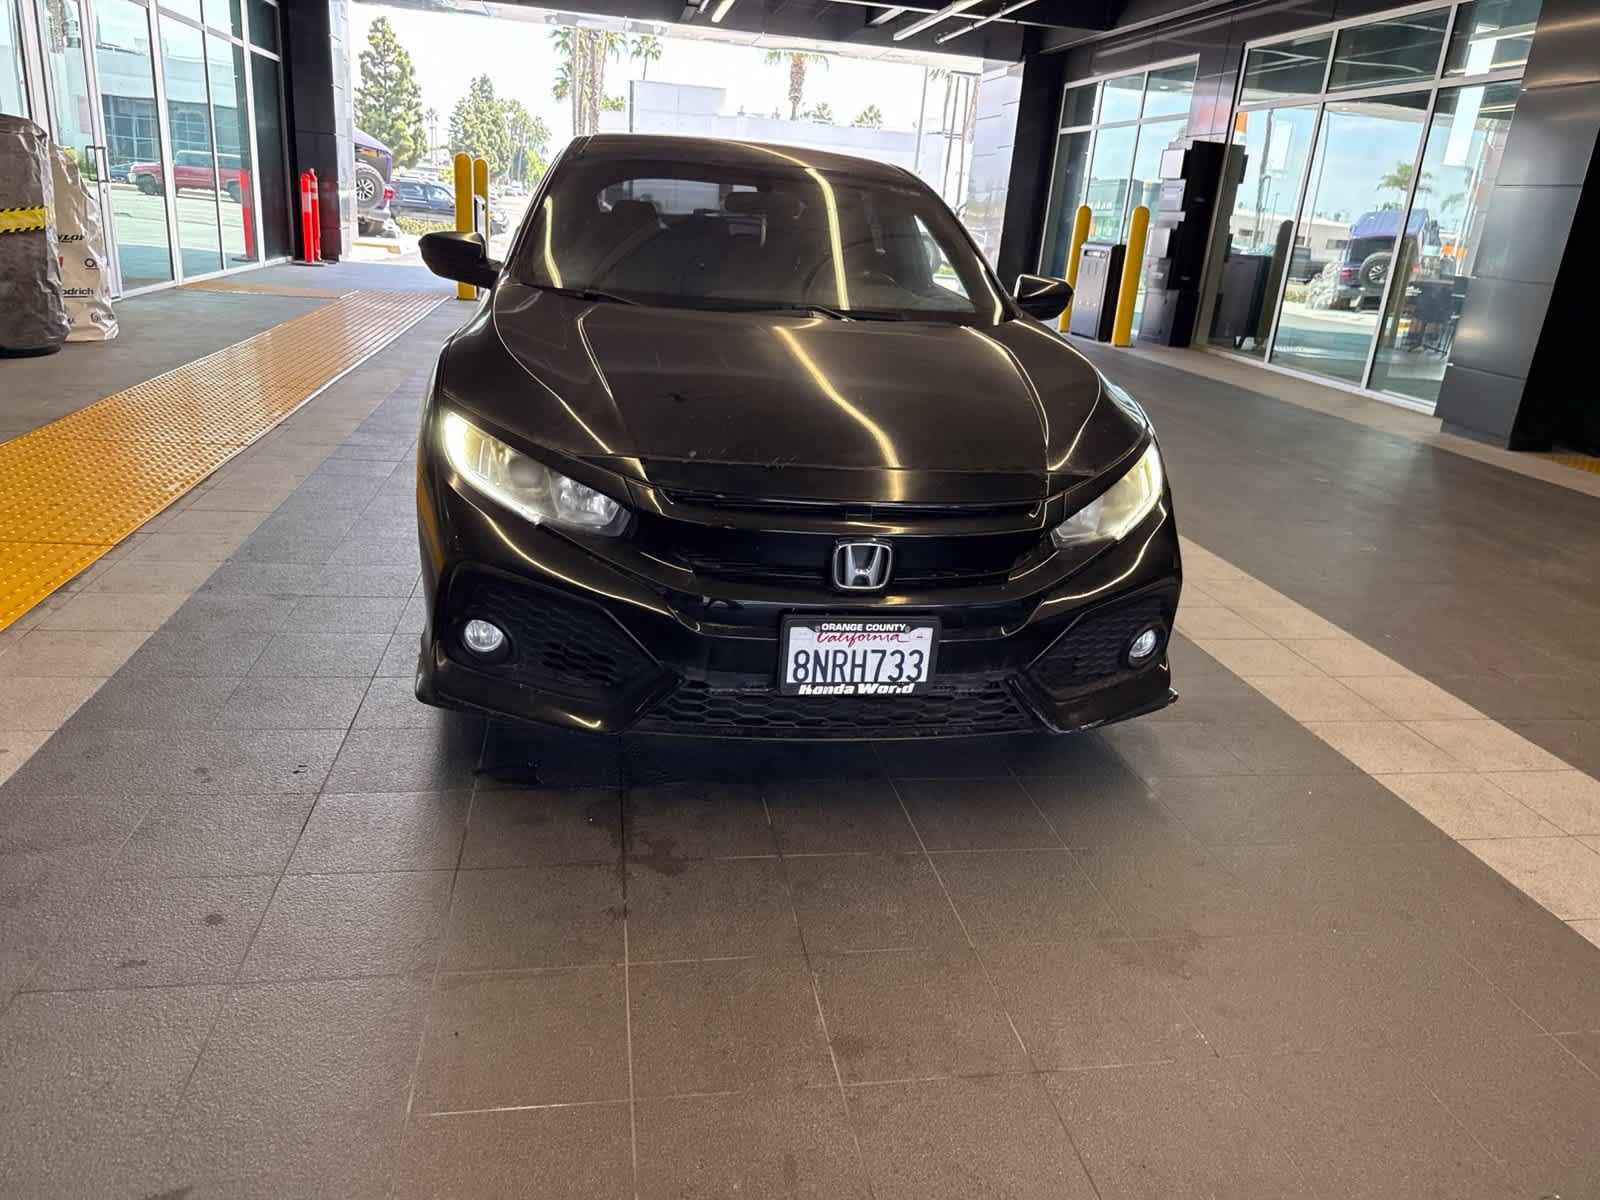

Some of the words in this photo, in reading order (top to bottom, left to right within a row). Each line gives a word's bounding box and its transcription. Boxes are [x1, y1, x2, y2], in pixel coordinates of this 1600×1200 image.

[821, 623, 863, 632] ORANGE
[866, 623, 907, 632] COUNTY
[816, 632, 911, 648] California
[792, 649, 924, 683] 8NRH733
[798, 683, 855, 695] Honda
[857, 683, 915, 694] World
